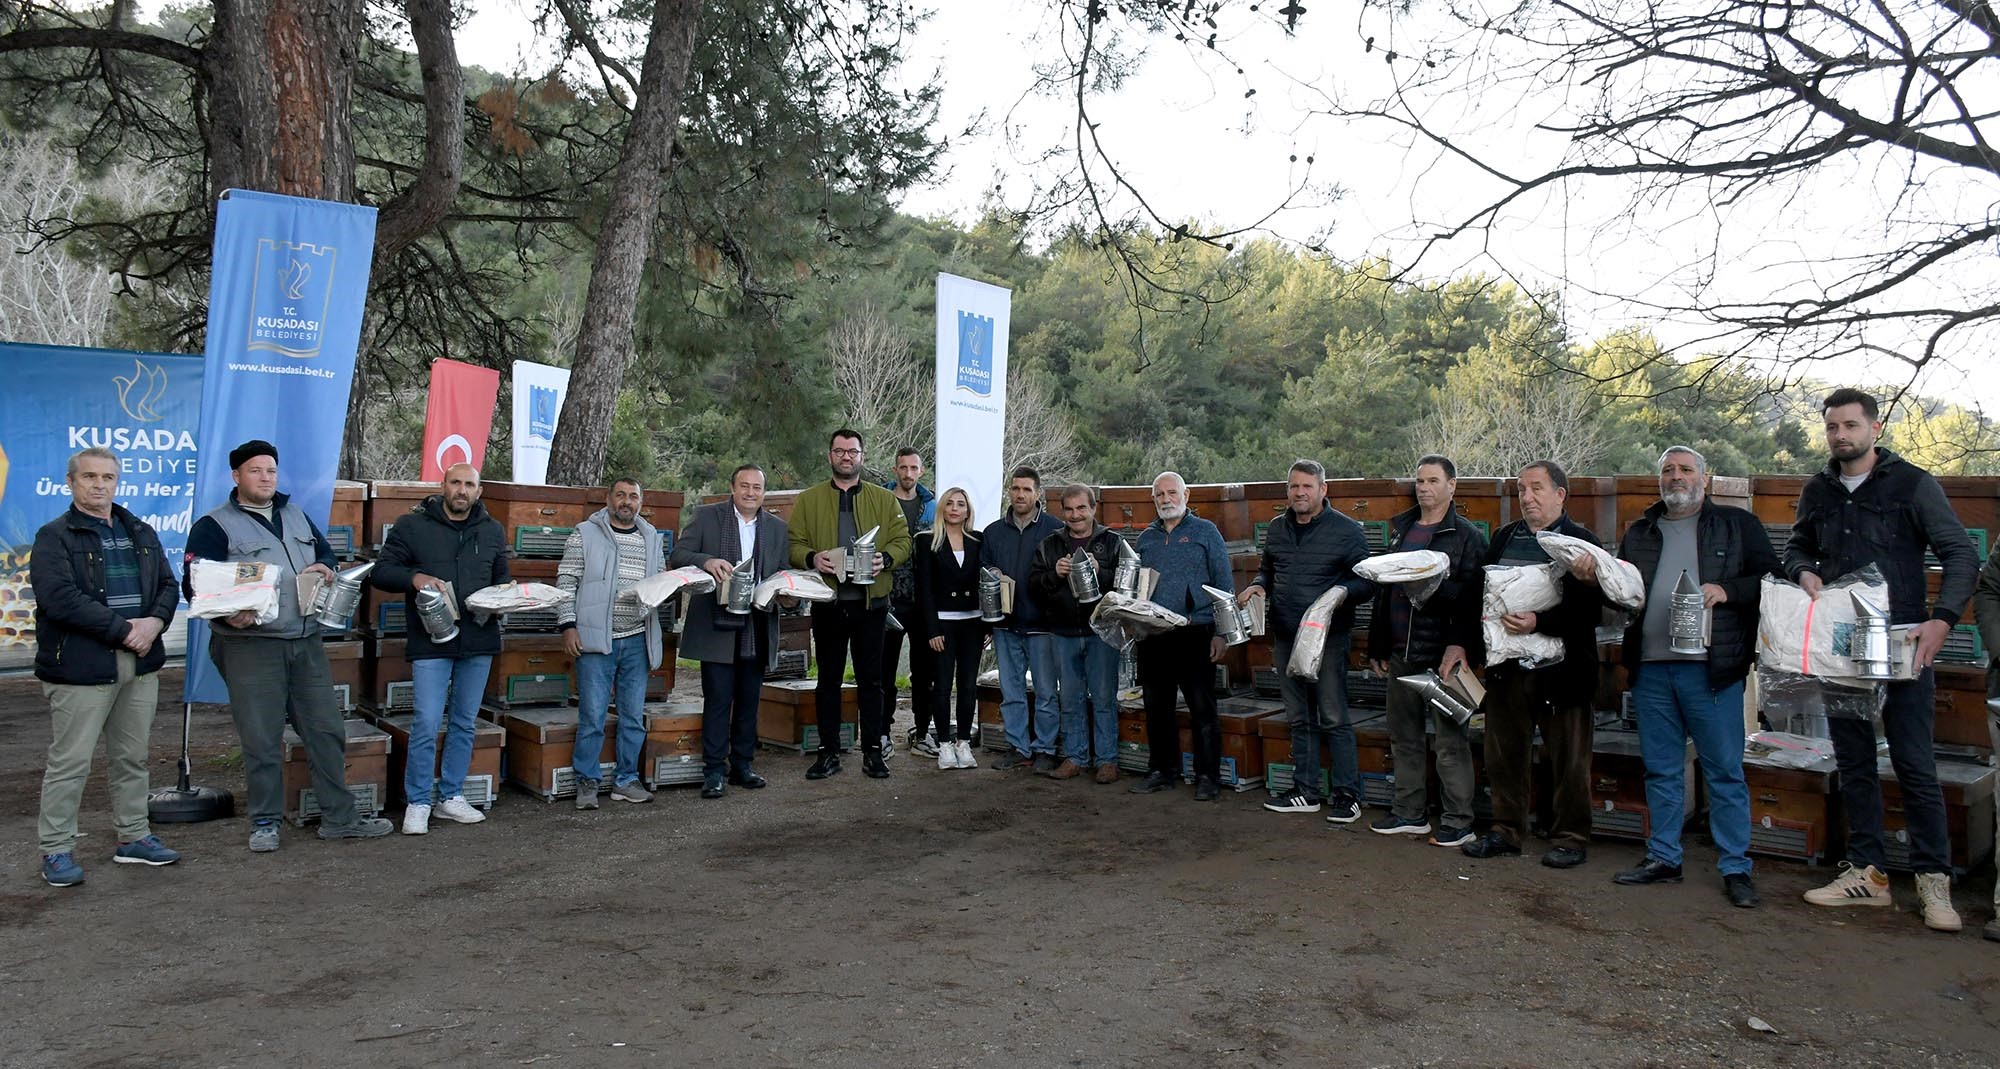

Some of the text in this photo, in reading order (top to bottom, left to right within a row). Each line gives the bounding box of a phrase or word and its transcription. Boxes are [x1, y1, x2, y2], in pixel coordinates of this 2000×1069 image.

[228, 363, 336, 379] www.kusadasi.bel.tr
[69, 426, 197, 451] KUŞADA
[122, 455, 197, 474] EDİYE
[144, 482, 181, 496] Her
